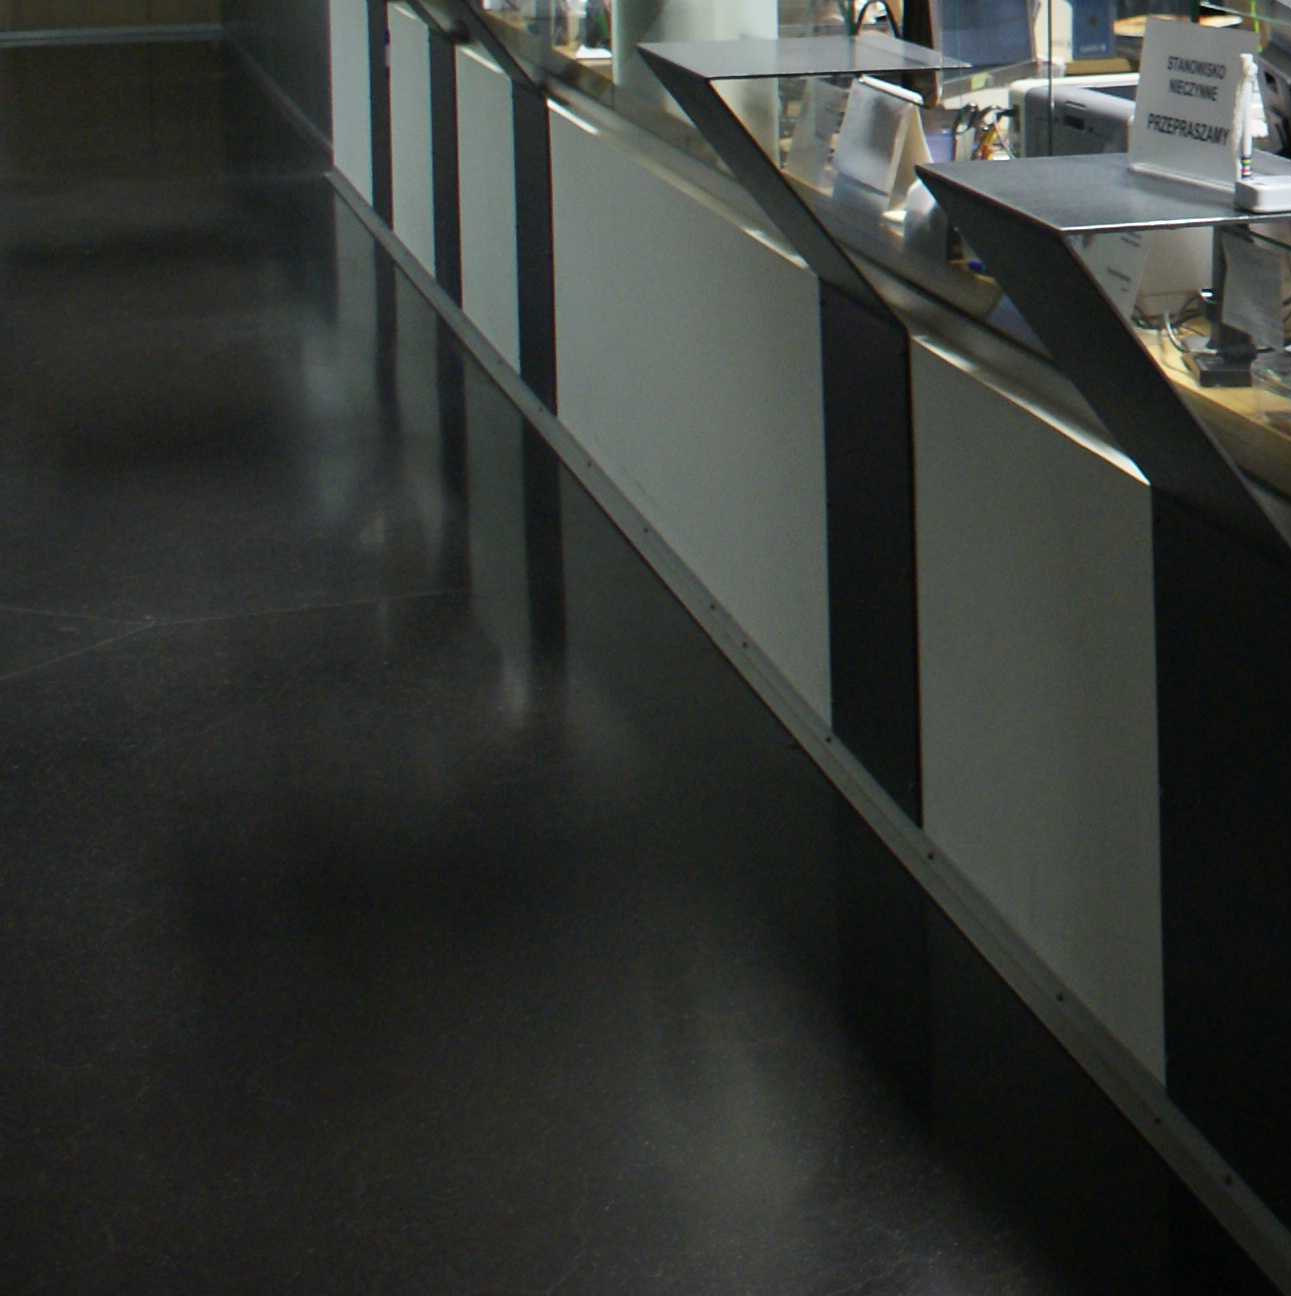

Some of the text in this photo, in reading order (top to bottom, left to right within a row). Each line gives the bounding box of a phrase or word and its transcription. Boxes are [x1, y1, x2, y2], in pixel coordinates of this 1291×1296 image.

[1167, 56, 1227, 80] STANOWISKO
[1169, 79, 1218, 102] NIECZYNNE
[1147, 113, 1230, 147] PRZEPRASZAMY
